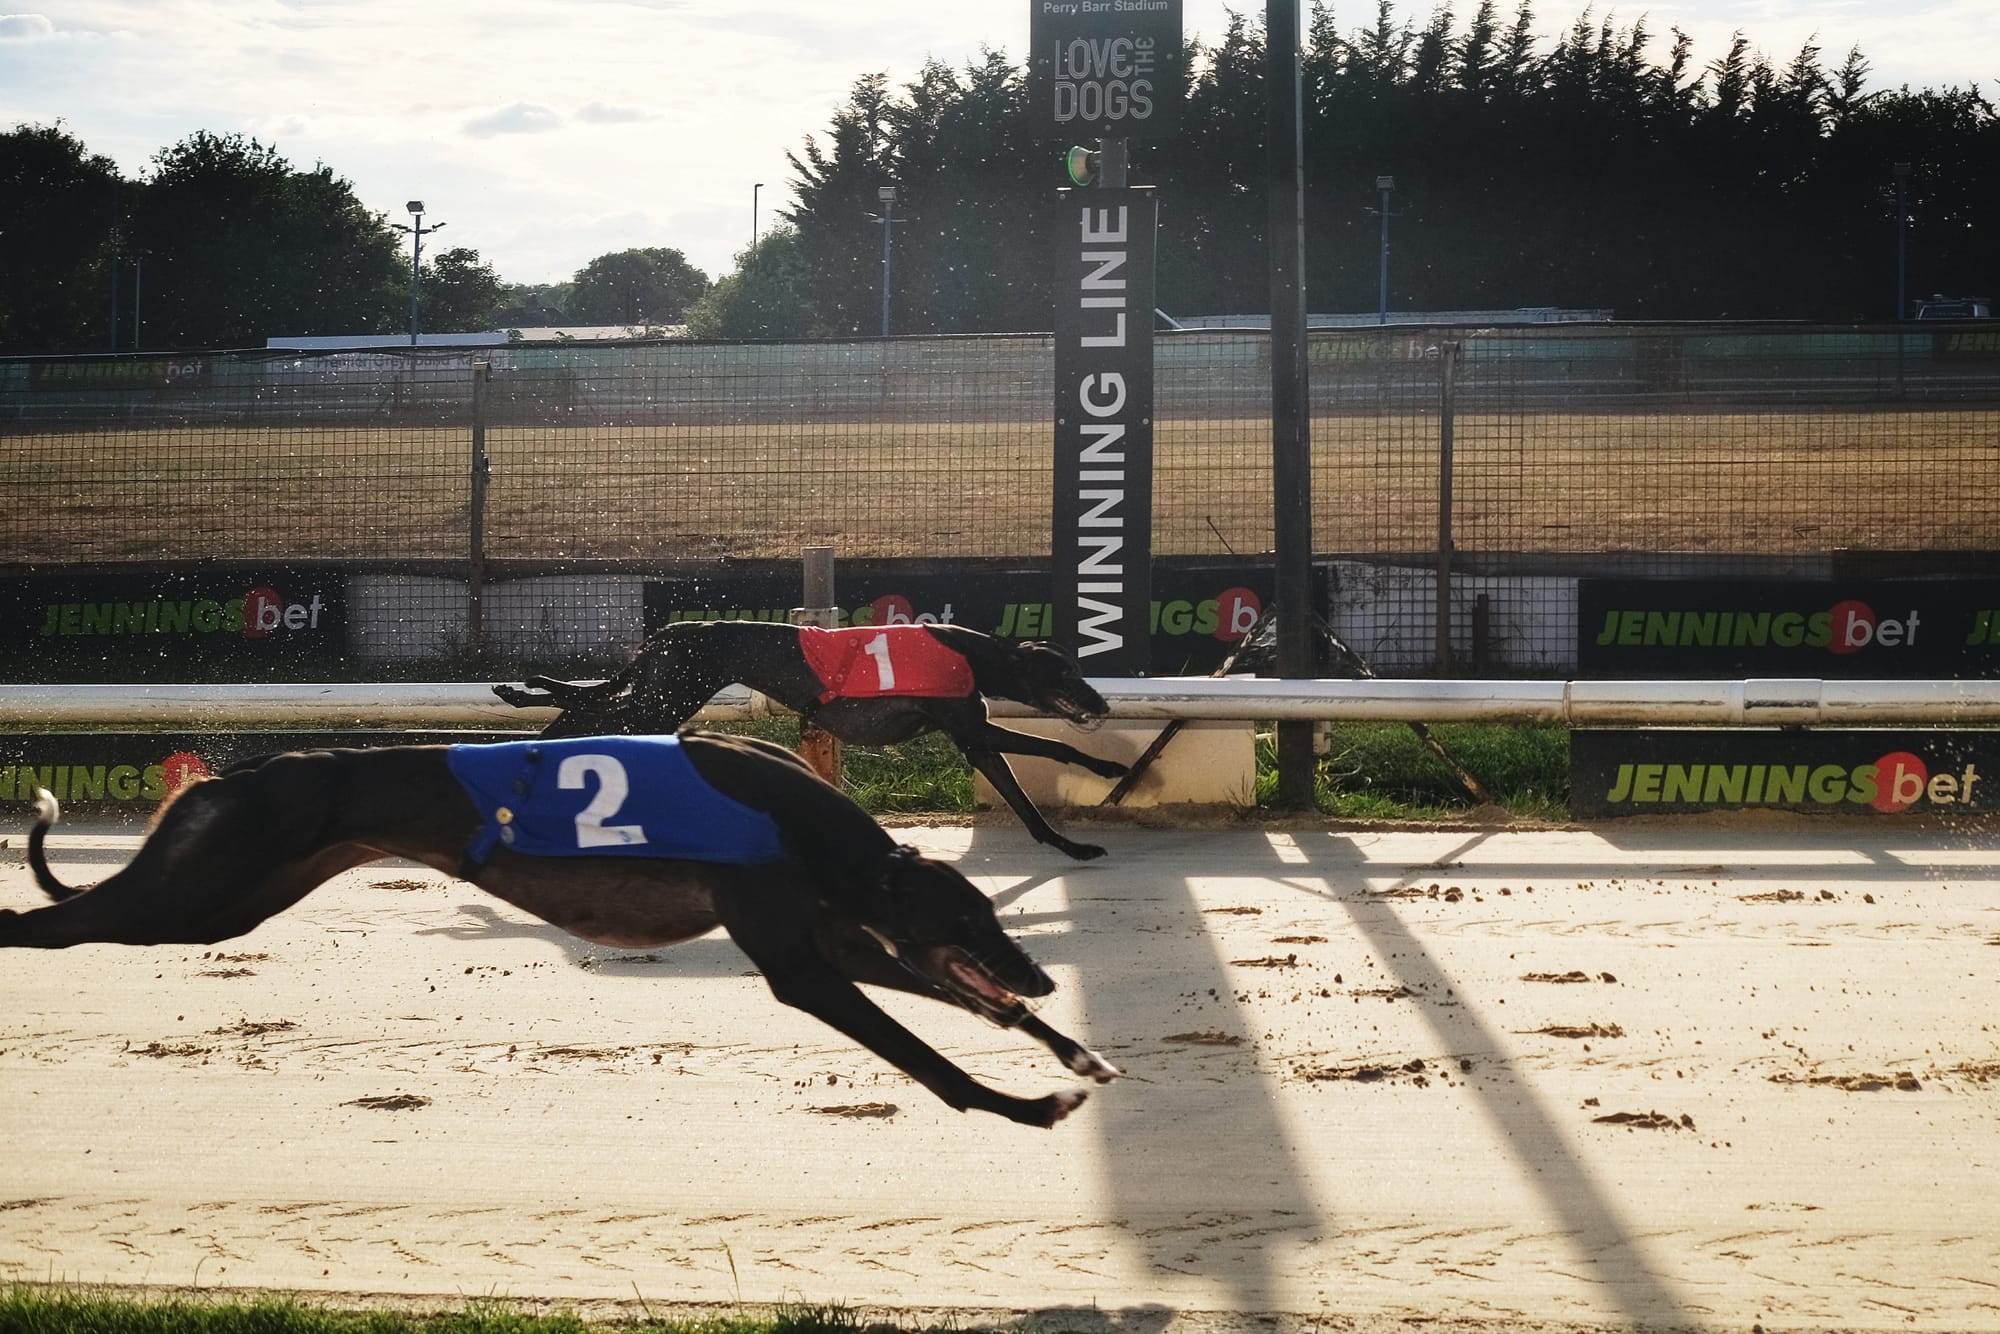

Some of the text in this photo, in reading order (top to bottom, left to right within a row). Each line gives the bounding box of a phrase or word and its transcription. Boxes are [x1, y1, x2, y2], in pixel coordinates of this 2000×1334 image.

[1043, 0, 1168, 15] Perry Barr Stadium
[1054, 37, 1155, 80] LOVE THE
[1054, 79, 1153, 122] DOGS
[1077, 205, 1128, 658] WINNING LINE
[864, 633, 896, 690] 1
[557, 754, 648, 848] 2
